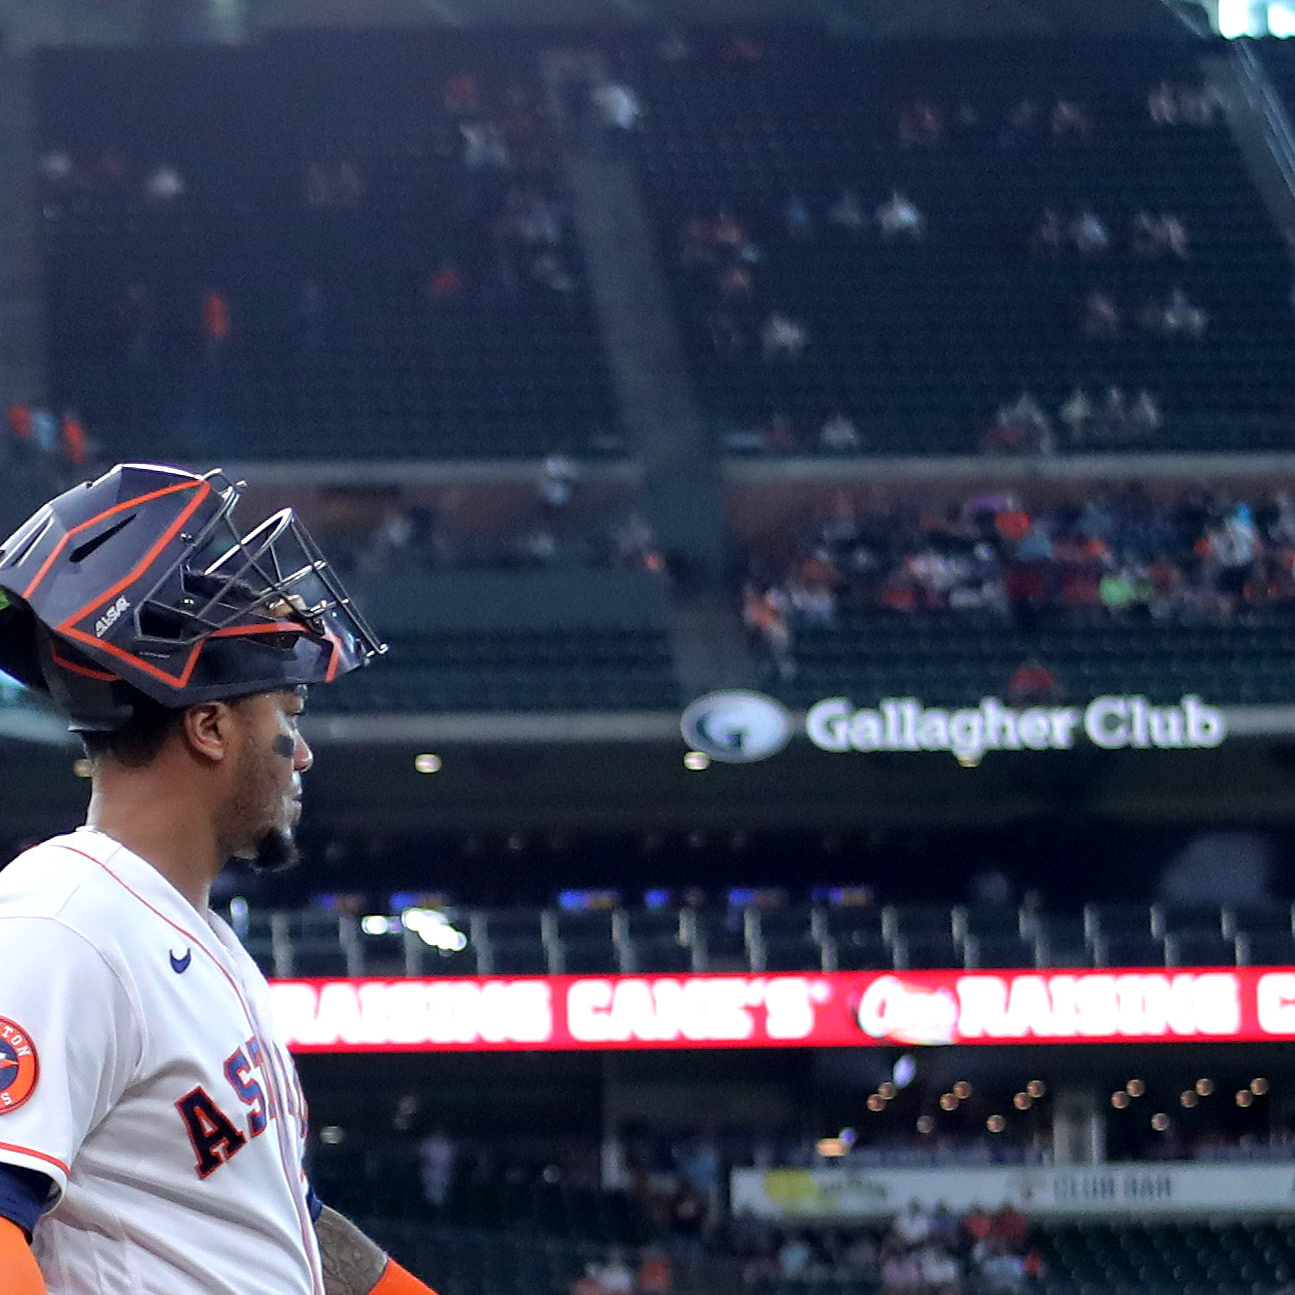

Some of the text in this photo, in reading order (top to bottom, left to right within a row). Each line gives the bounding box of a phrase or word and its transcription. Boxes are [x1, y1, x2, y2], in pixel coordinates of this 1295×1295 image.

[806, 695, 1227, 756] Gallagher Club
[956, 973, 1241, 1038] RAISING
